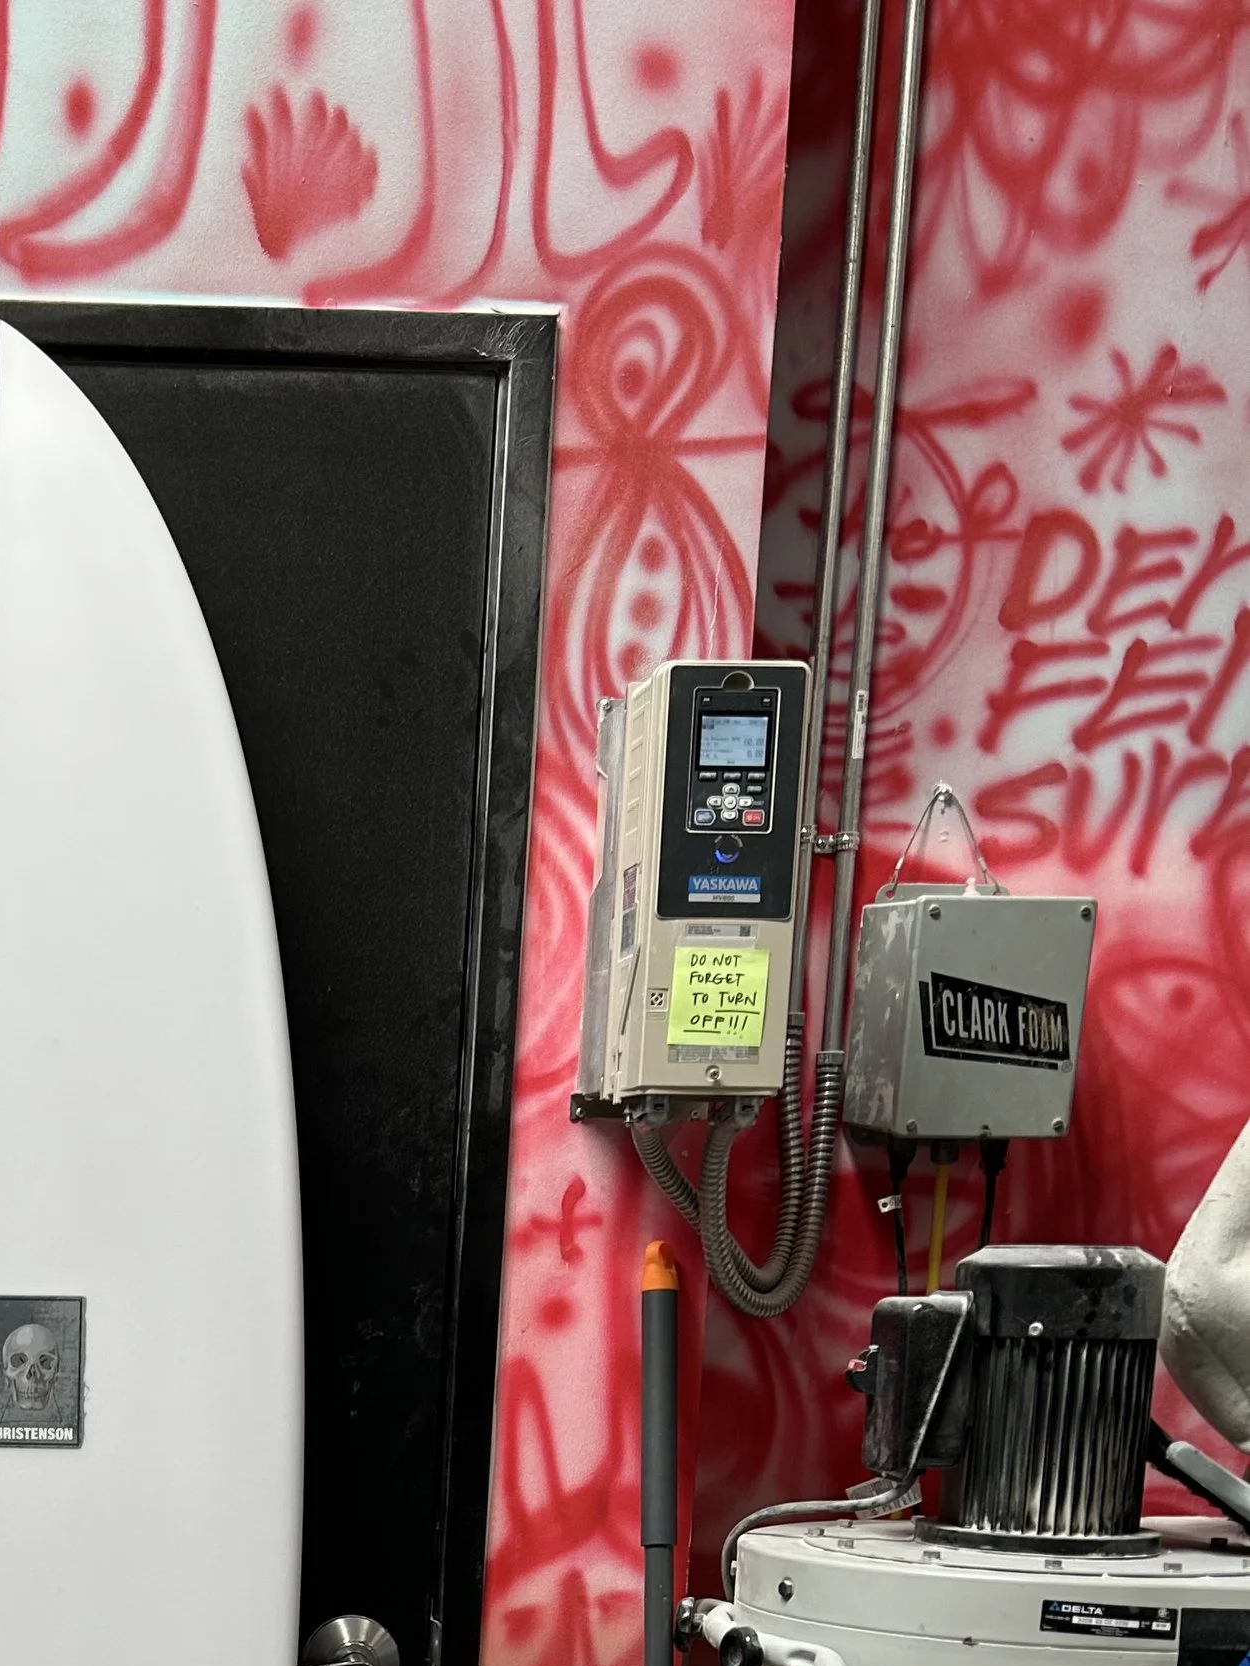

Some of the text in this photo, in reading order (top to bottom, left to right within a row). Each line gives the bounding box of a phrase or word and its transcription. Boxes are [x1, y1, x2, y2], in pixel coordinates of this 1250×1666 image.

[692, 877, 758, 891] YASKAWA
[691, 953, 742, 968] DO NOT
[689, 970, 745, 986] FORGET
[692, 991, 757, 1008] TO TURN
[689, 1014, 748, 1039] OFF!!!
[941, 988, 1063, 1053] CLARK FOAM
[1060, 1603, 1104, 1616] DELTA
